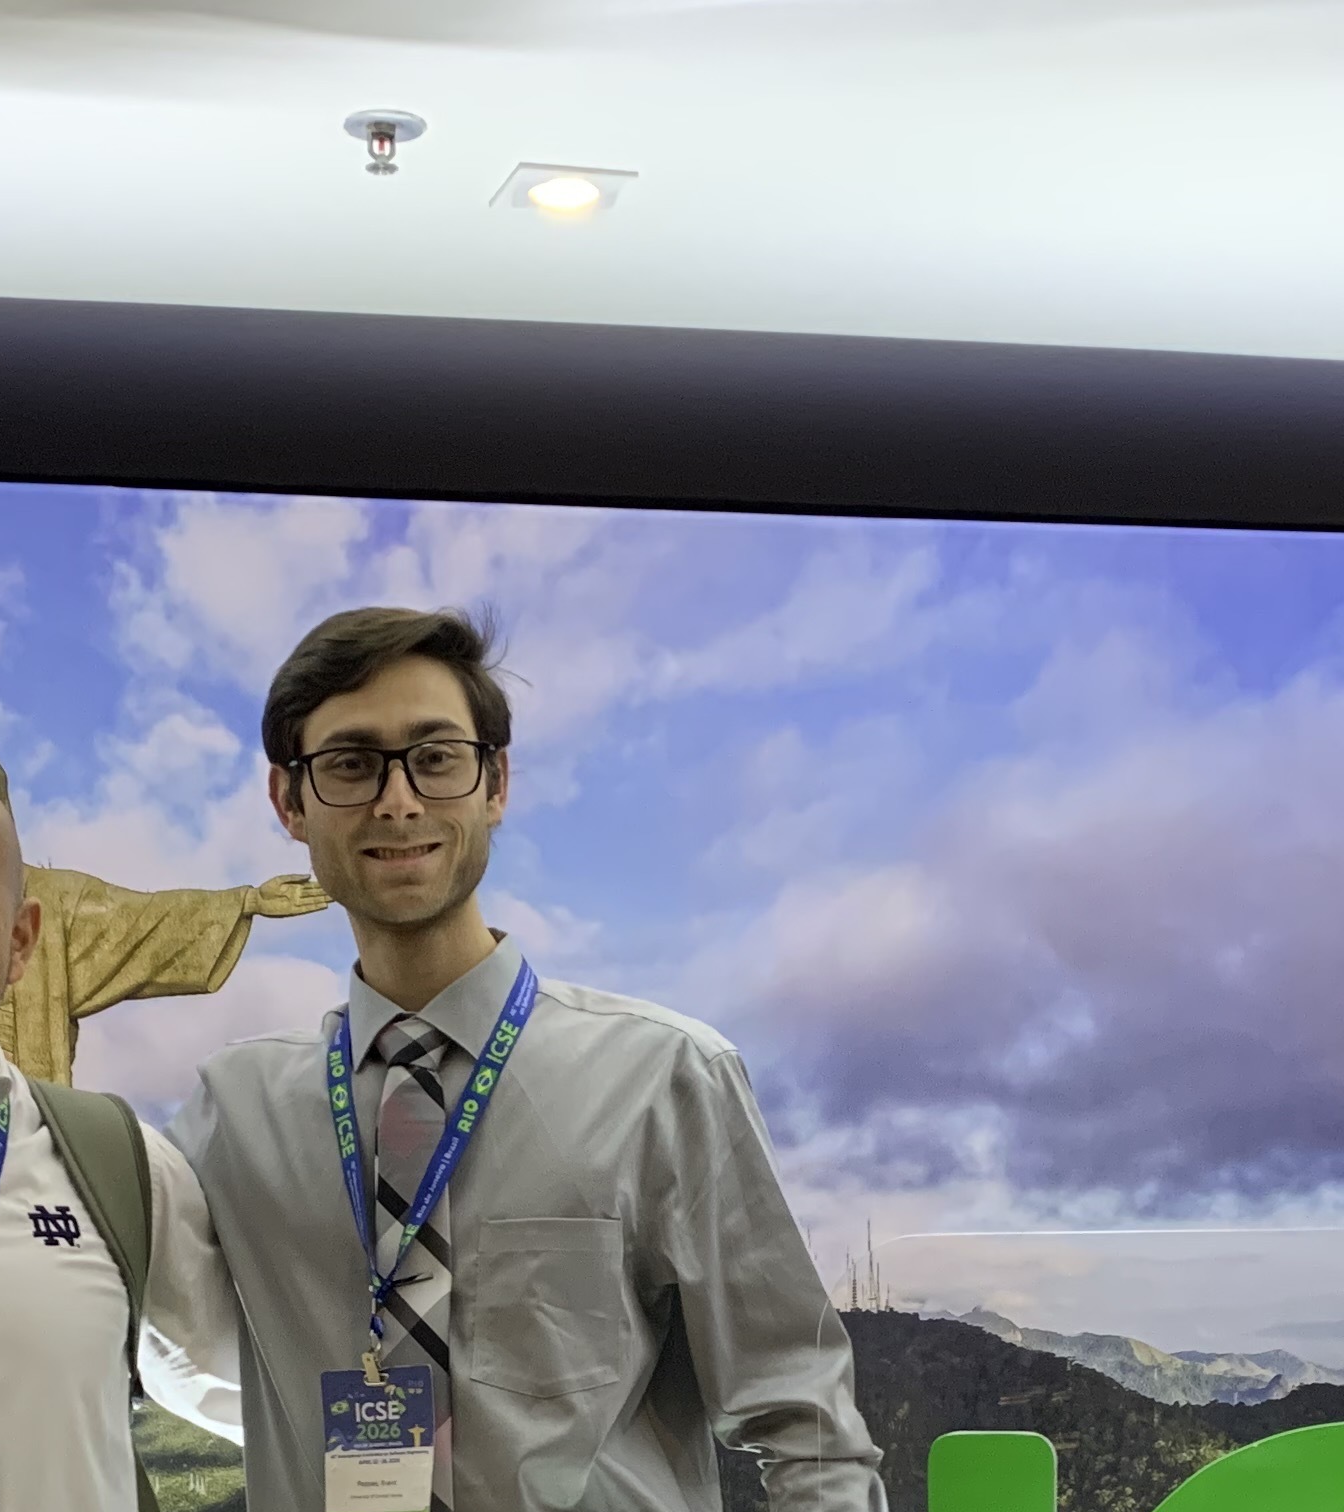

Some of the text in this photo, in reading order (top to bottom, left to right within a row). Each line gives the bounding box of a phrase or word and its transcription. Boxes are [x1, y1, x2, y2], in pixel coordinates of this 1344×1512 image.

[486, 1020, 519, 1065] ICSE
[329, 1050, 345, 1078] RIO
[457, 1099, 479, 1133] RIO
[336, 1112, 355, 1159] ICSE
[355, 1400, 401, 1422] ICSE
[357, 1422, 401, 1440] 2026
